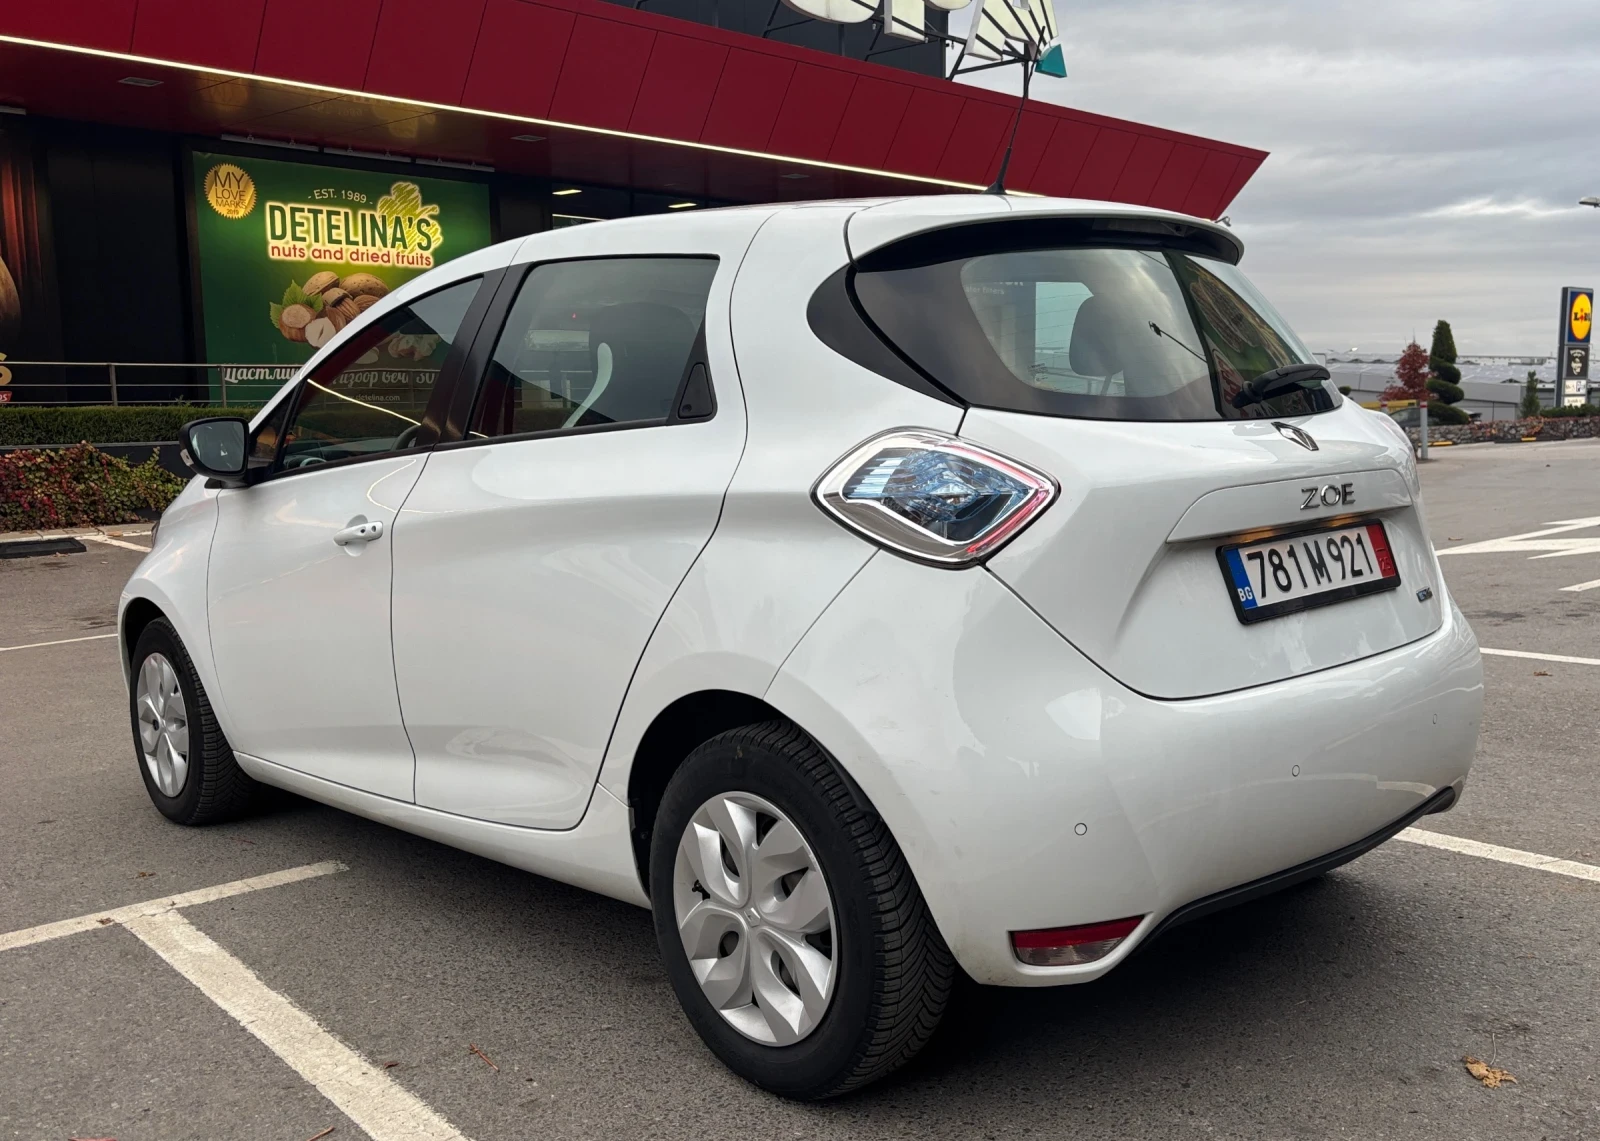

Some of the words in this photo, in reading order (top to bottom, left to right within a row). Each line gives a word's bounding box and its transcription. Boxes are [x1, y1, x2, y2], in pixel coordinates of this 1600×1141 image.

[214, 170, 245, 190] MY
[215, 188, 246, 202] LOVE
[215, 199, 247, 209] MARKS
[313, 188, 337, 200] EST.
[341, 189, 367, 204] 1989
[268, 204, 434, 253] DETELINA'S
[271, 244, 306, 259] nuts
[311, 247, 344, 262] and
[350, 248, 392, 265] dried
[396, 251, 433, 268] fruits
[1300, 483, 1356, 510] ZOE
[1237, 587, 1253, 602] BG
